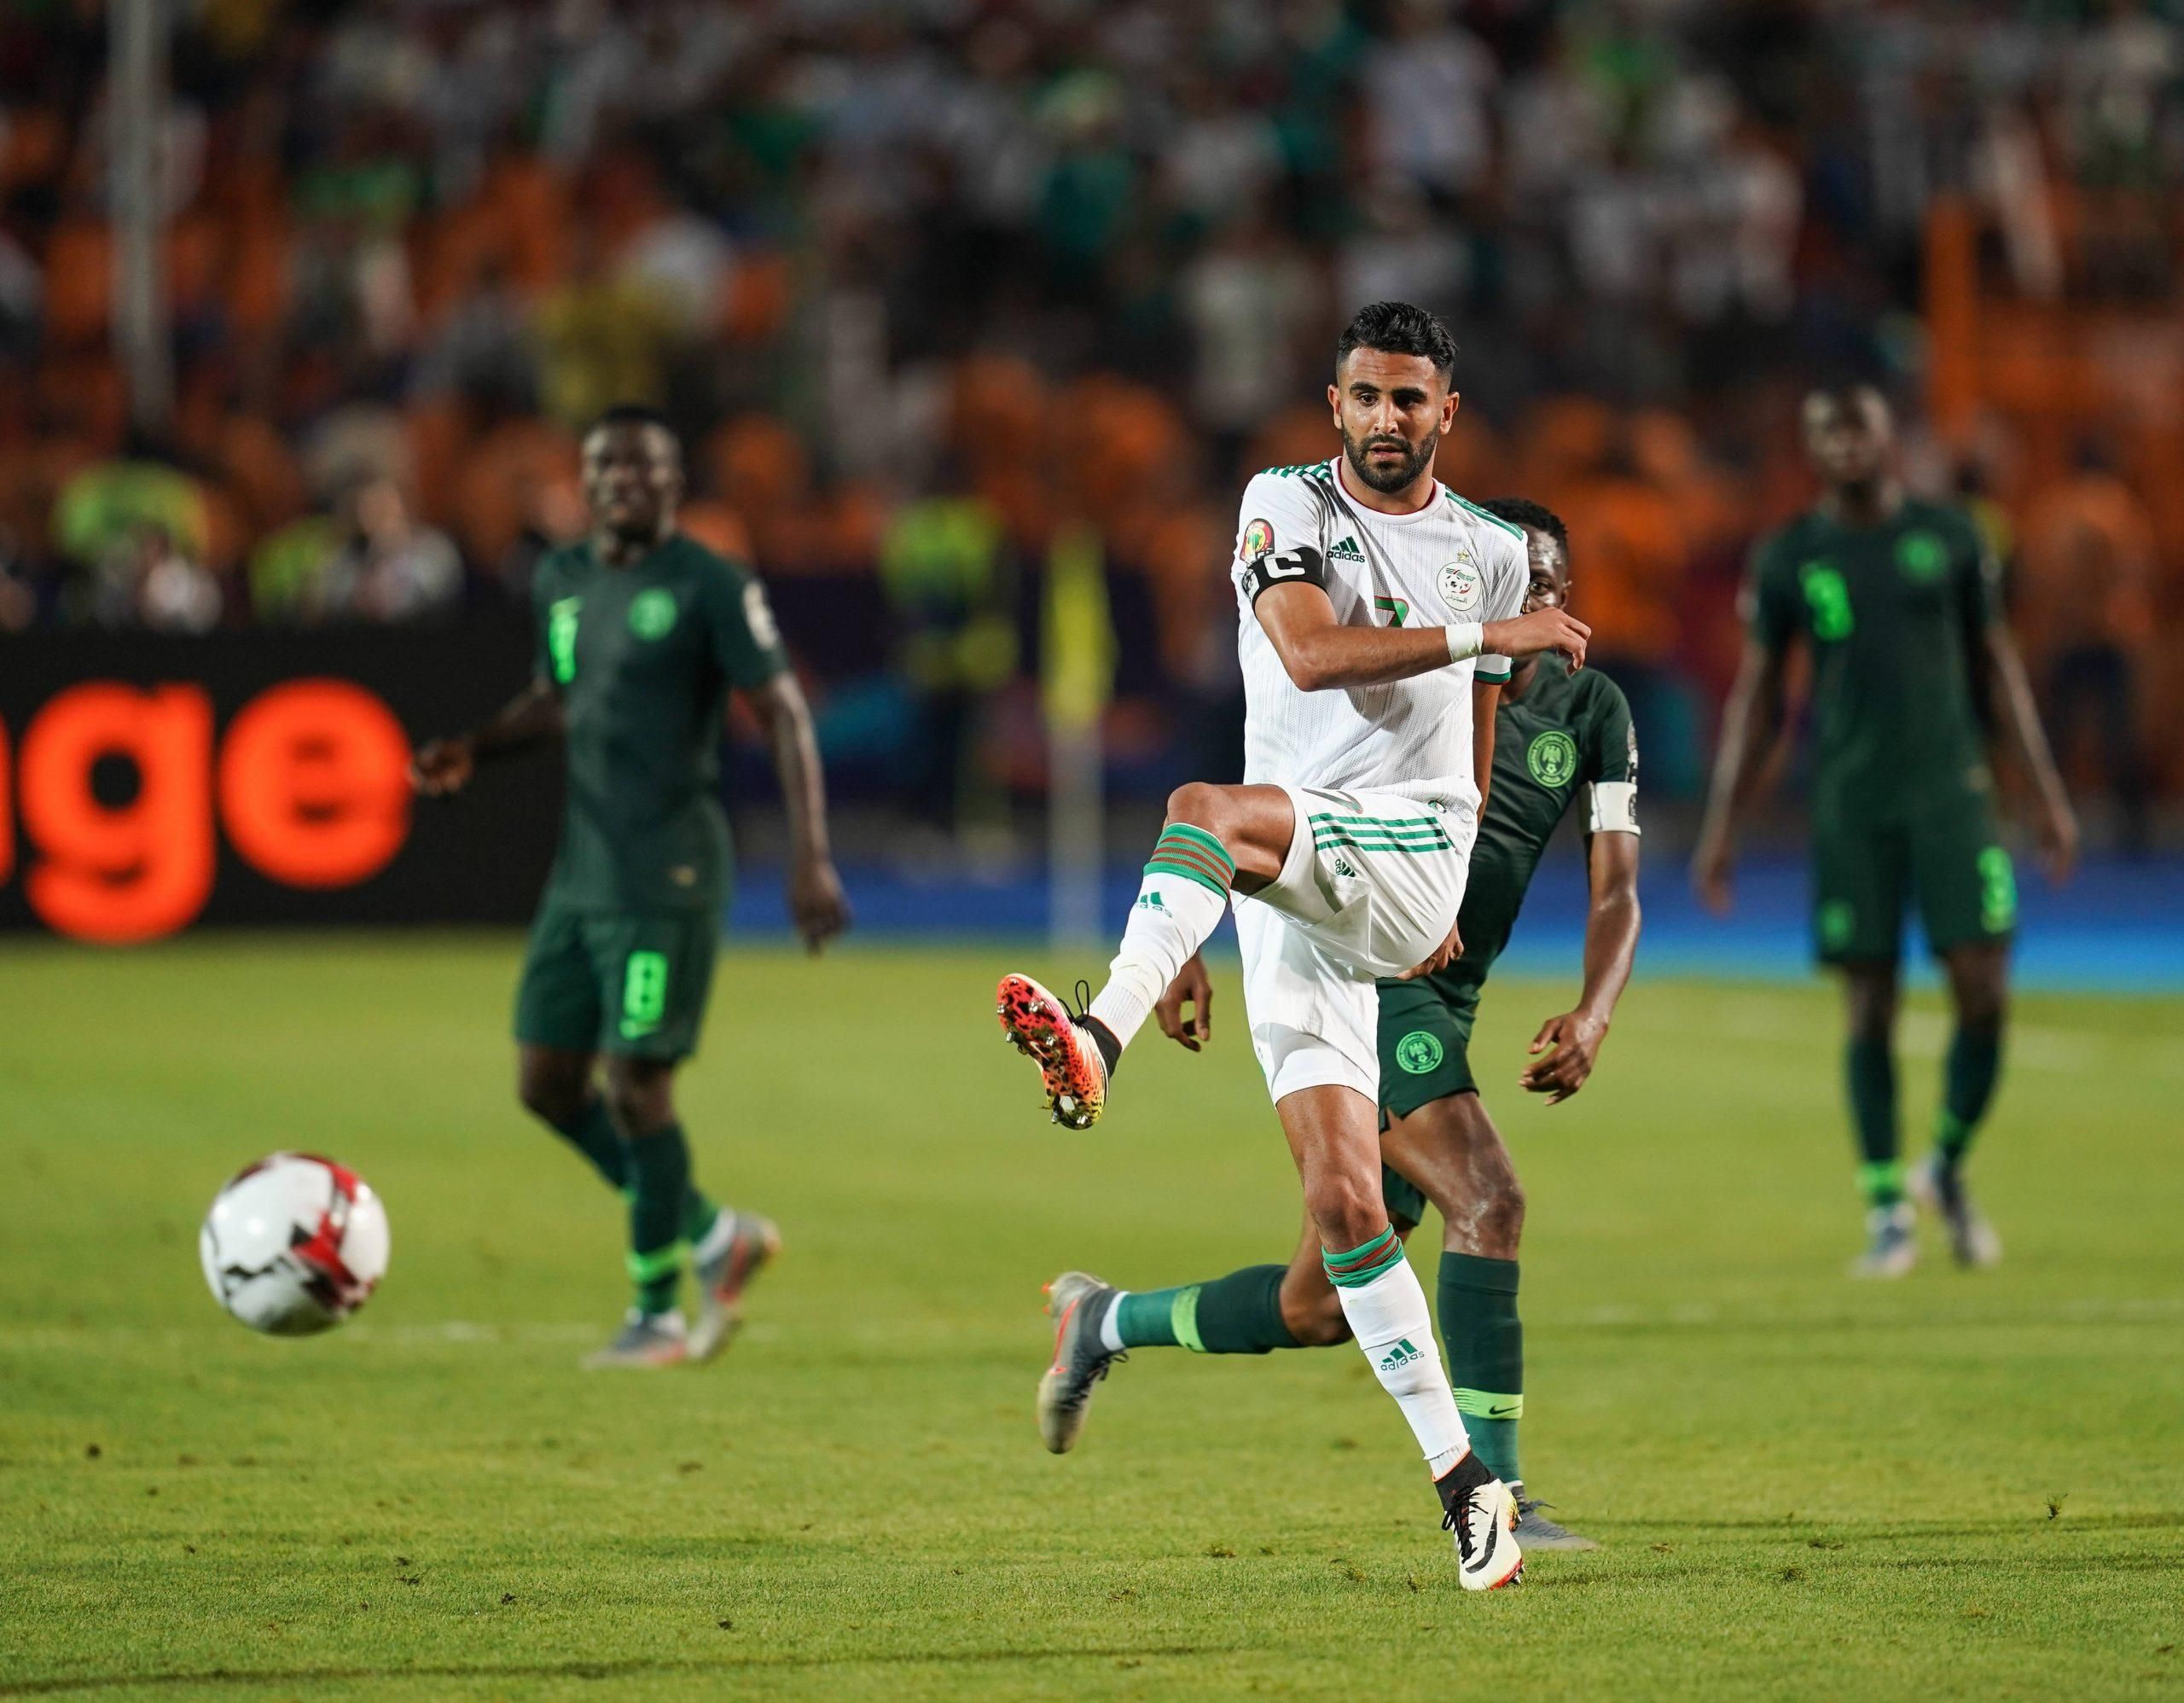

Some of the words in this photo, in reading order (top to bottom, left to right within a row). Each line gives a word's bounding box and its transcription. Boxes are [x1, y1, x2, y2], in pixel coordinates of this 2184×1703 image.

[1263, 550, 1305, 578] C
[1326, 549, 1366, 563] adidas
[0, 676, 415, 946] ge
[1380, 1350, 1425, 1371] adidas
